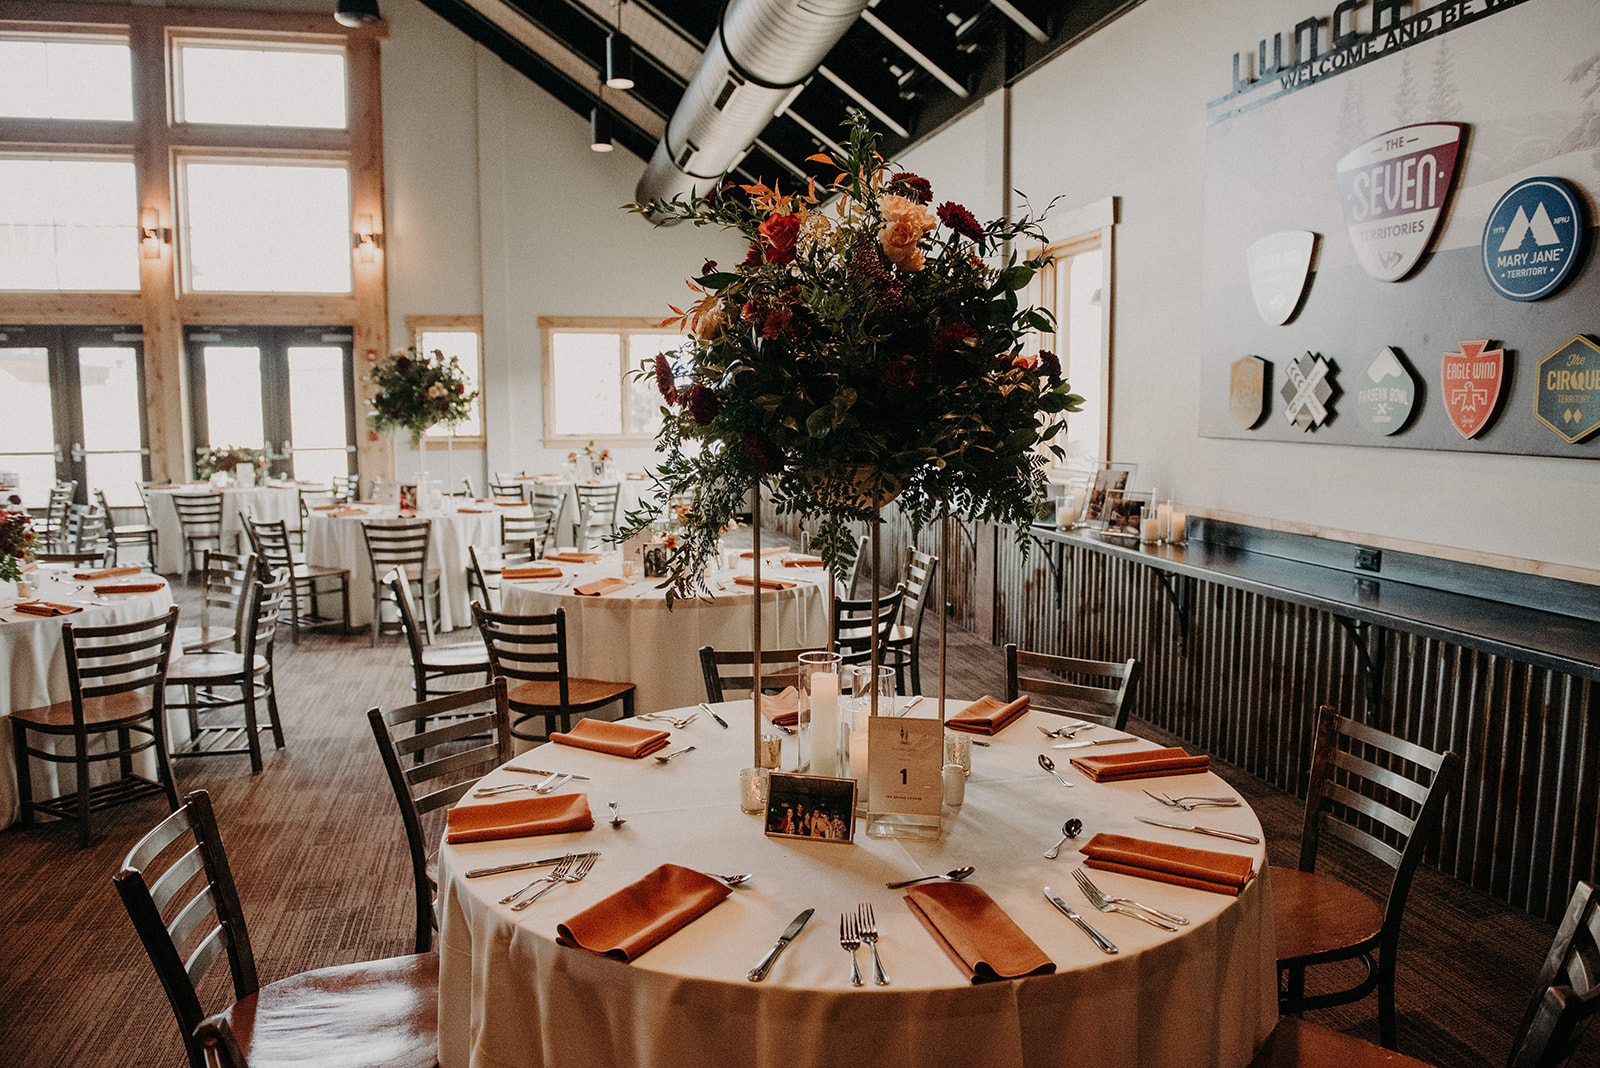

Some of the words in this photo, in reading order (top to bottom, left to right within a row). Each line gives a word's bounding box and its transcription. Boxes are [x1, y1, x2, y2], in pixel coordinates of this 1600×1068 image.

[1280, 37, 1377, 89] WELCOME
[1383, 18, 1433, 49] AND
[1440, 1, 1474, 25] BE
[1385, 136, 1404, 152] THE
[1351, 153, 1437, 221] SEVEN
[1359, 219, 1425, 243] TERRITORIES
[1497, 252, 1528, 268] MARY
[1530, 248, 1561, 264] JANE
[1507, 266, 1548, 279] TERRITORY
[1566, 353, 1586, 367] The
[1446, 362, 1471, 380] EAGLE
[1472, 361, 1496, 379] WIND
[1546, 369, 1600, 391] CIRQUE
[1558, 394, 1591, 404] TERRITORY
[900, 769, 908, 785] 1
